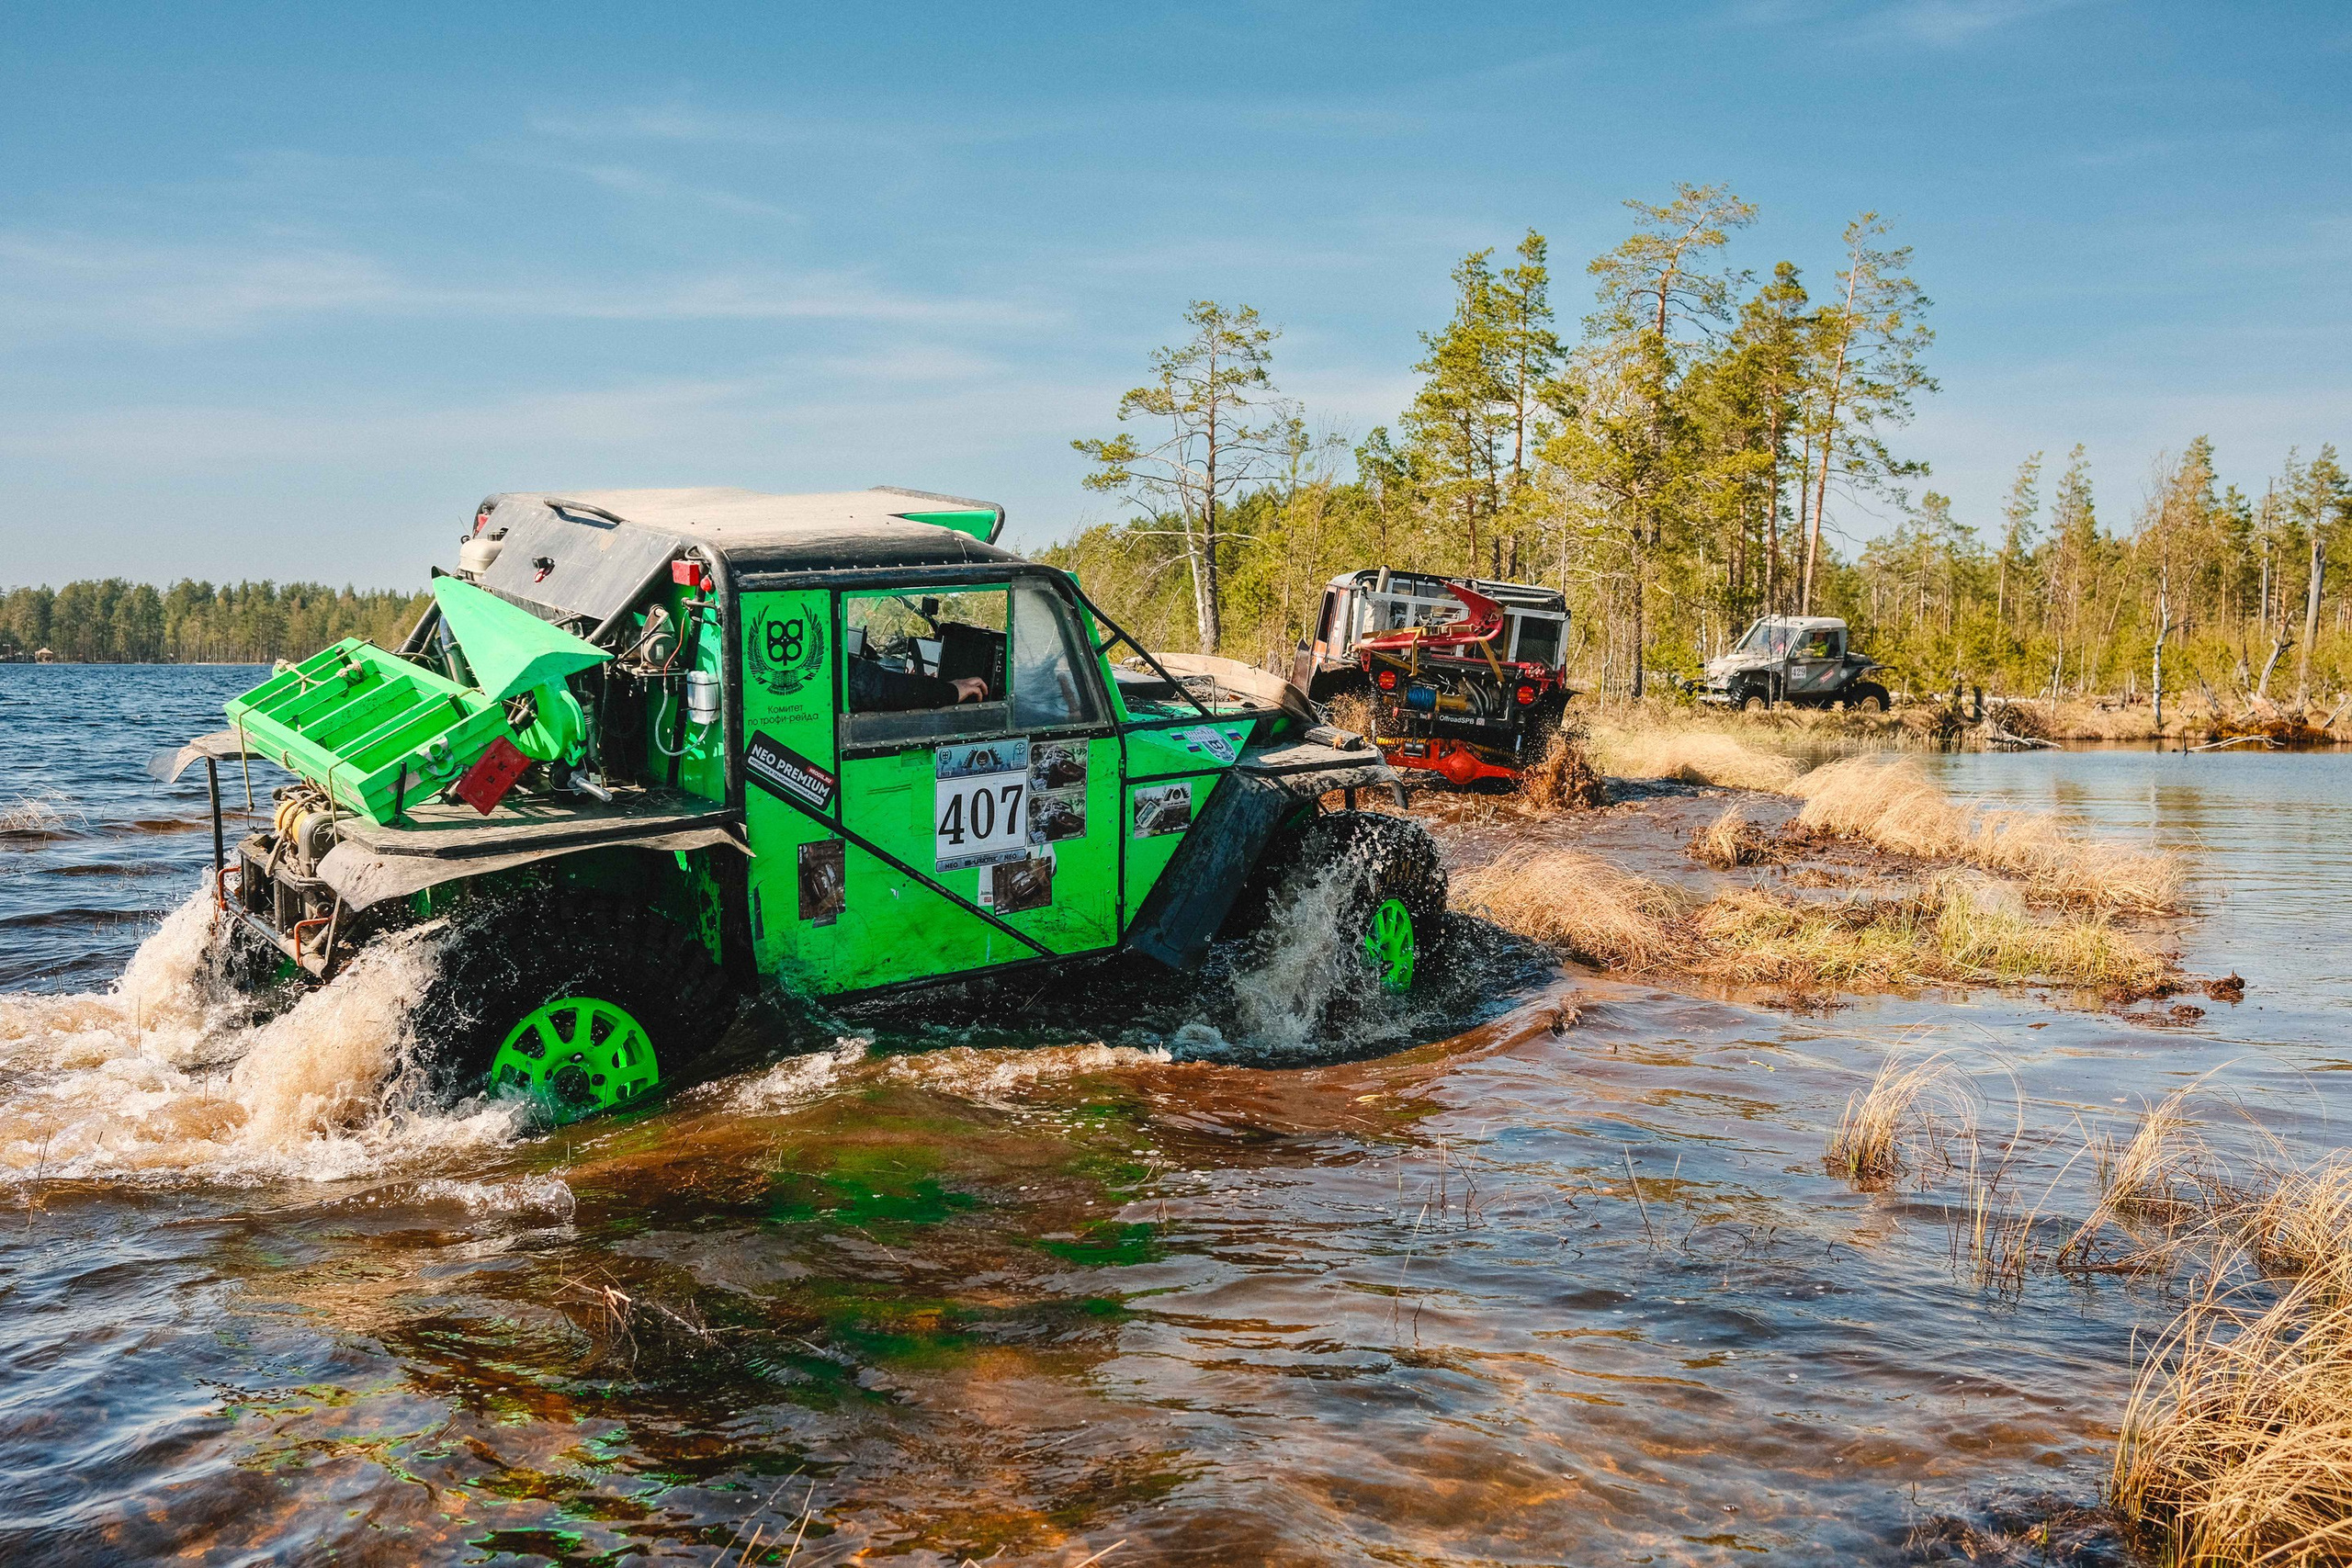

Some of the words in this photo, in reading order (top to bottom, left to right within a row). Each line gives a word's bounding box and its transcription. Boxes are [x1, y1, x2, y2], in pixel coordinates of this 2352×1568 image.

[1792, 668, 1806, 677] 429
[767, 704, 804, 714] Комитет
[760, 712, 819, 727] трофи-рейда
[1439, 715, 1475, 725] OffroadSPB
[752, 743, 776, 765] NEO
[776, 759, 830, 797] PREMIUM
[938, 784, 1023, 845] 407
[944, 862, 958, 870] NEO
